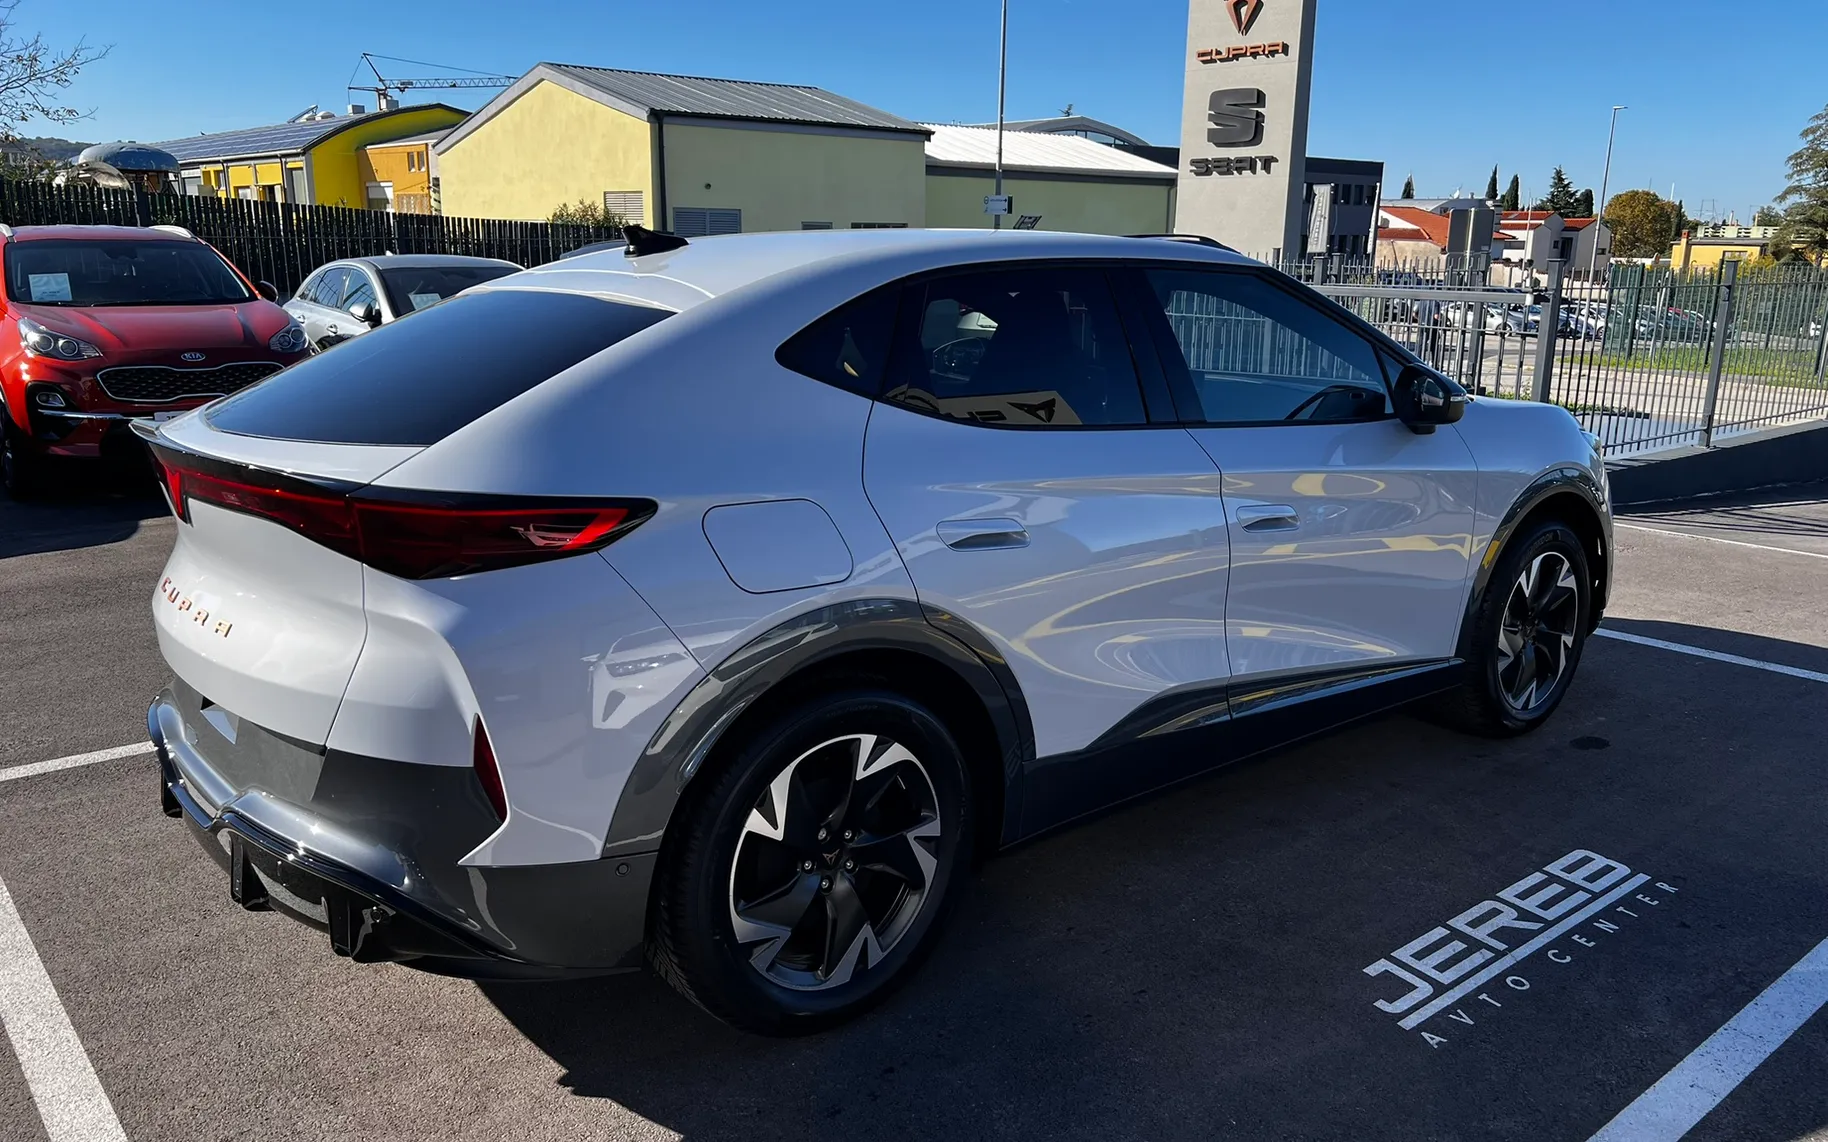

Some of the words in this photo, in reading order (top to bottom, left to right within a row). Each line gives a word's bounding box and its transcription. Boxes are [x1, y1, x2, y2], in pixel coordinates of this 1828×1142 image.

[1196, 41, 1288, 63] CUPRA
[1189, 155, 1279, 176] SEAT
[183, 352, 203, 360] KIA
[161, 577, 233, 638] CUPRA
[1362, 849, 1631, 1014] JEREB
[1420, 975, 1530, 1048] AVTO
[1547, 881, 1679, 963] CENTER
